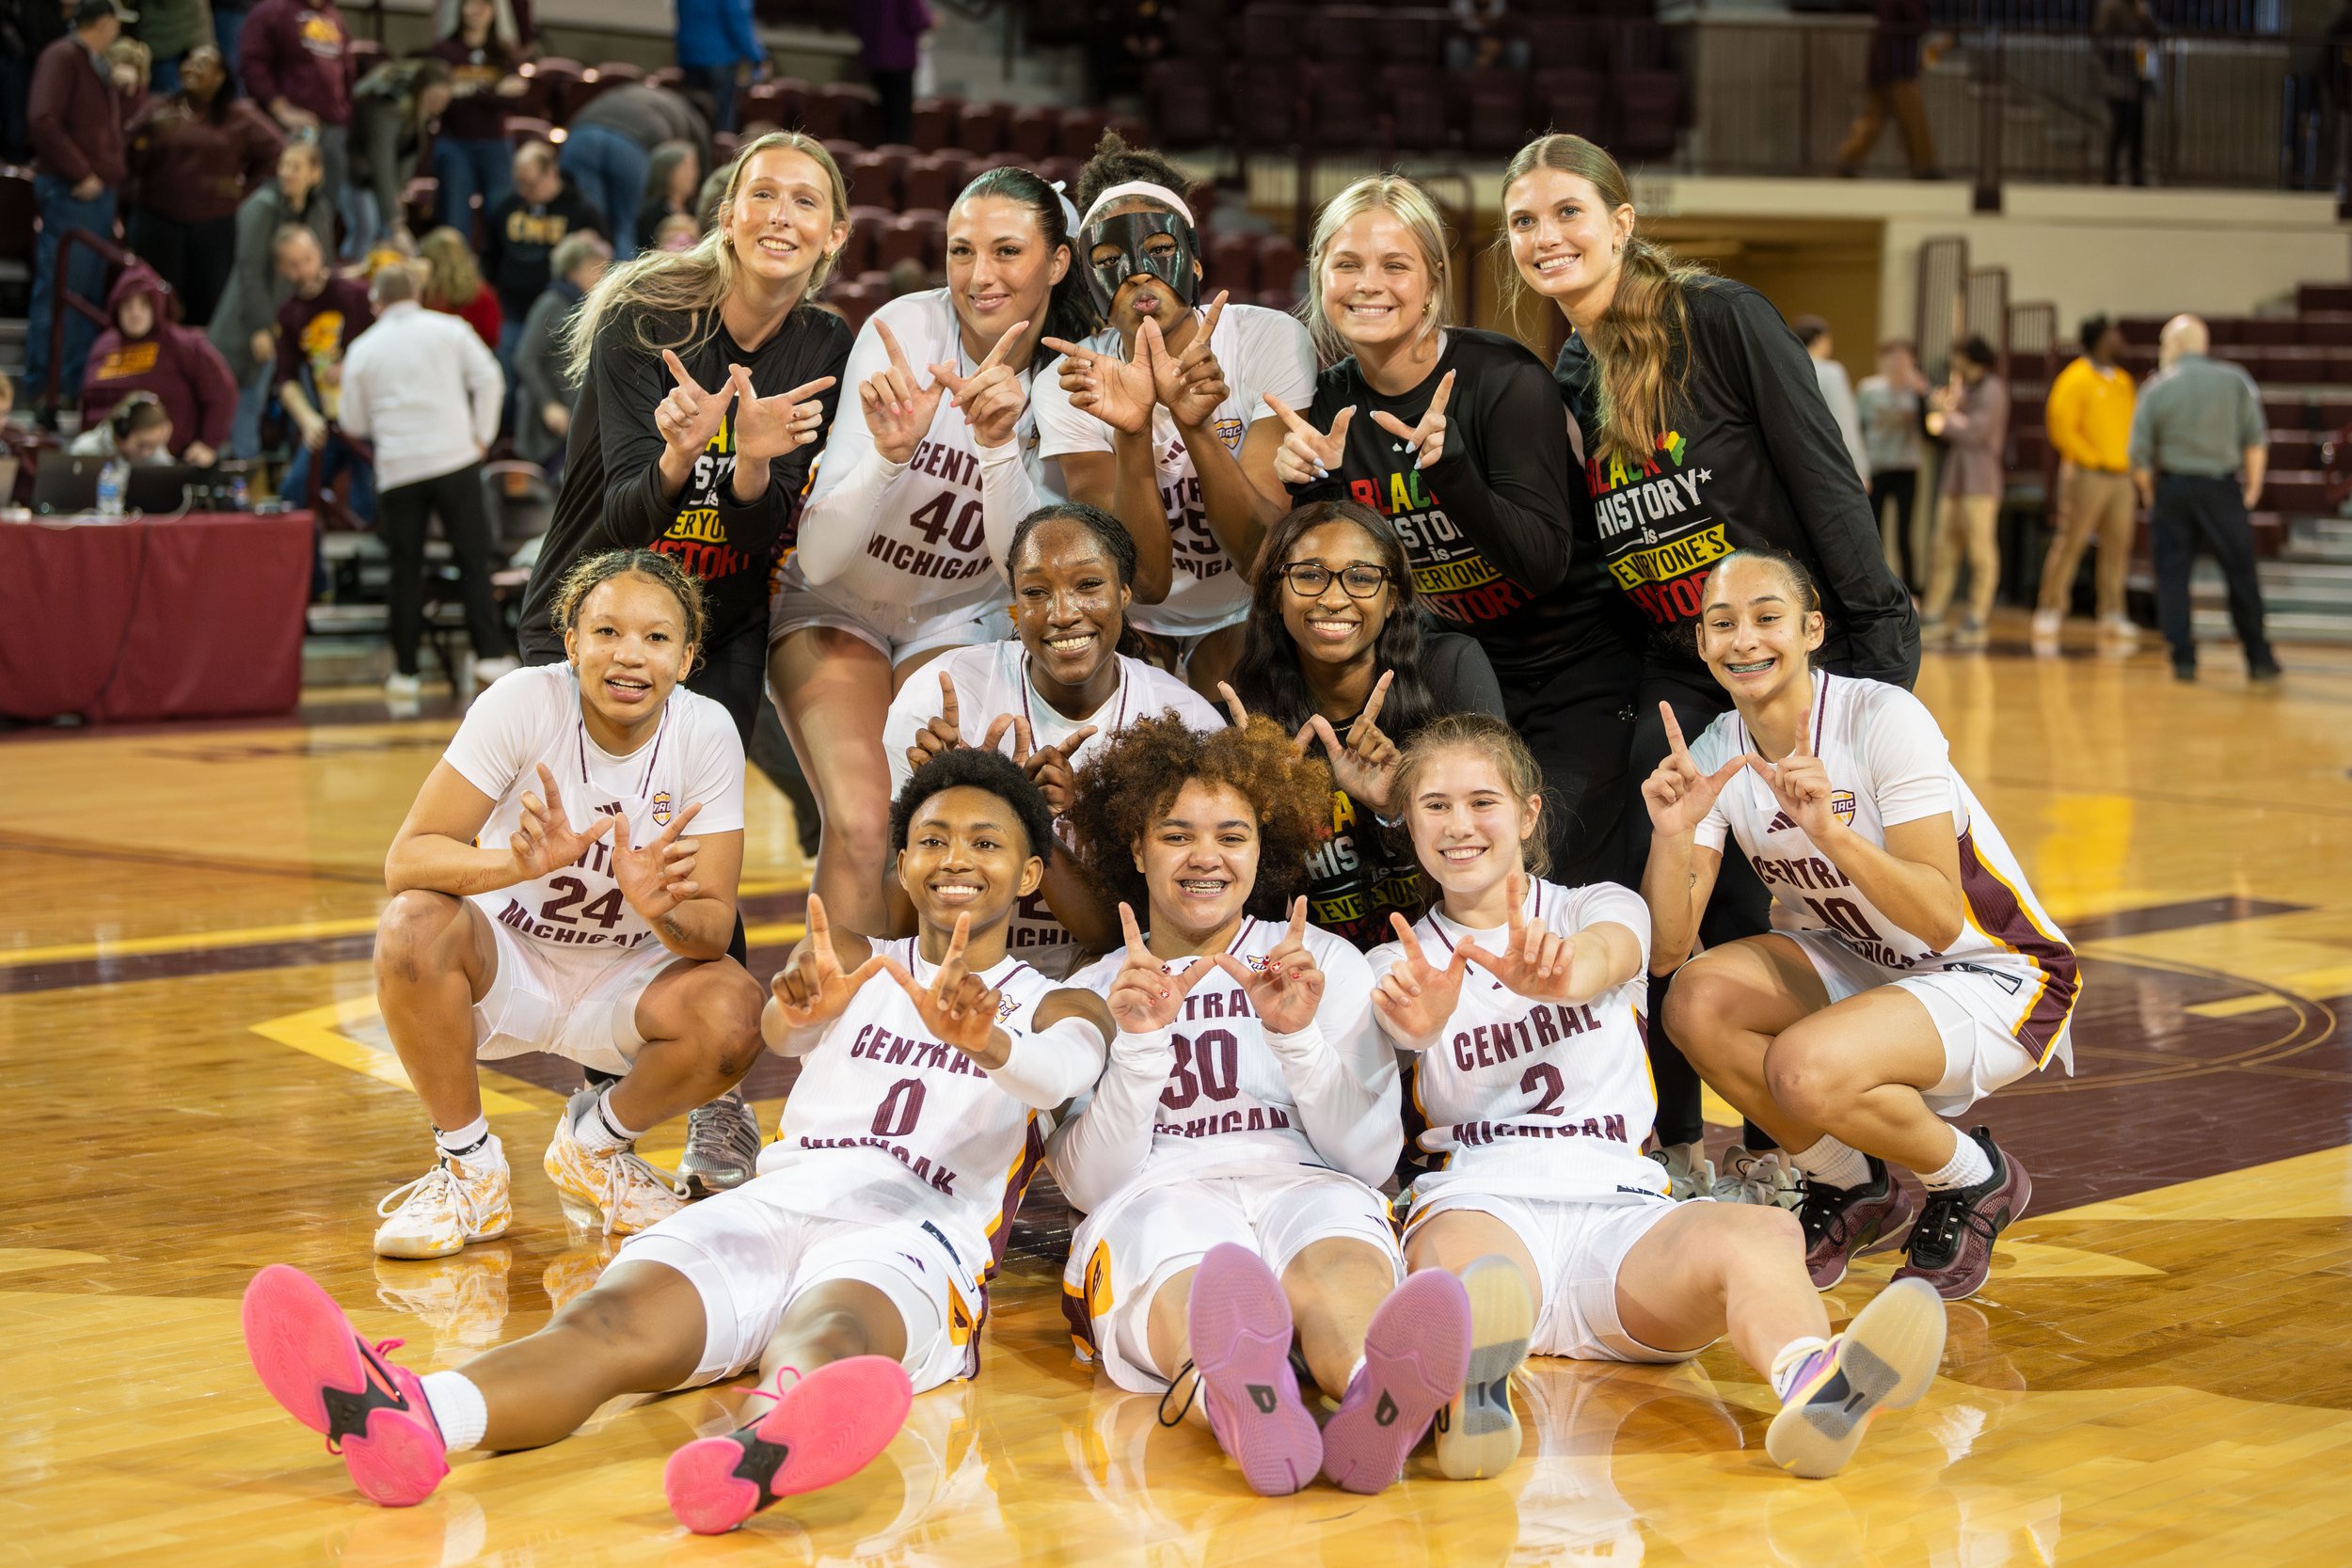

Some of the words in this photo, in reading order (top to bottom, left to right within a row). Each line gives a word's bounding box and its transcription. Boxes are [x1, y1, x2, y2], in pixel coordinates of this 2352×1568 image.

[910, 439, 983, 492] CENT
[1351, 470, 1439, 516] BLAC
[1595, 468, 1702, 540] HISTORY
[910, 490, 985, 553] 40
[1641, 526, 1659, 545] is
[1428, 546, 1451, 562] is
[1752, 856, 1851, 890] CENTRA
[540, 875, 625, 929] 24
[1803, 896, 1883, 942] 10
[1453, 1004, 1602, 1072] CENTRAL
[1158, 1029, 1240, 1111] 30
[1519, 1062, 1565, 1117] 2
[870, 1077, 927, 1137] 0
